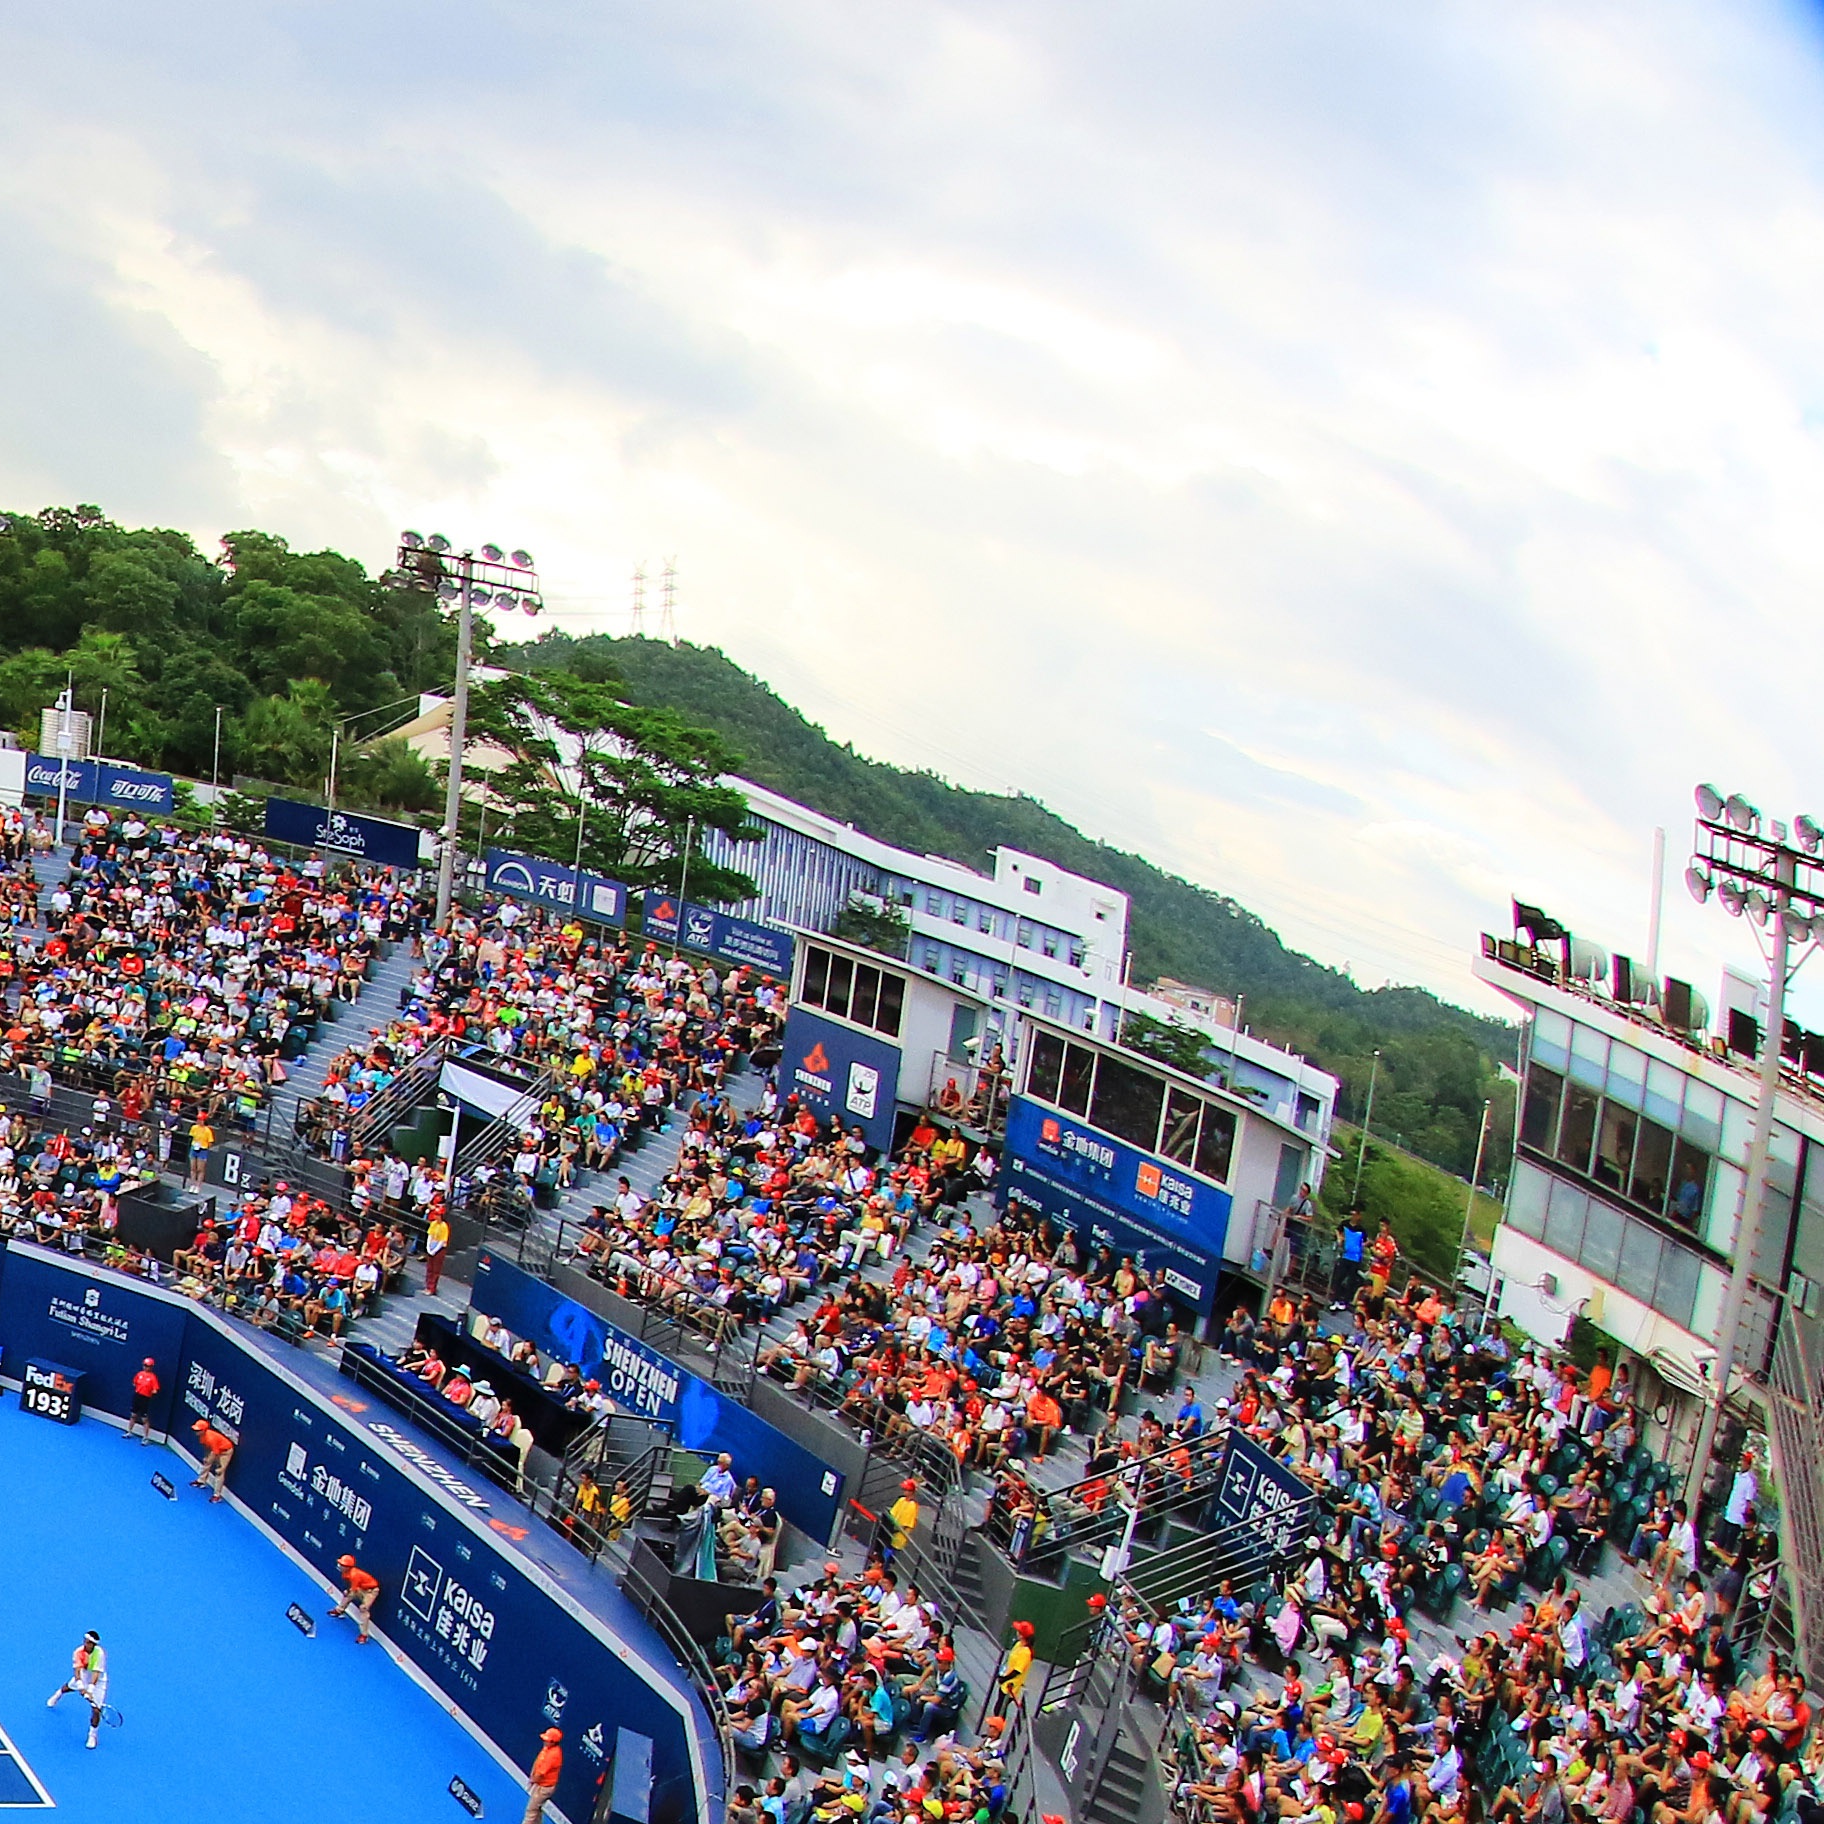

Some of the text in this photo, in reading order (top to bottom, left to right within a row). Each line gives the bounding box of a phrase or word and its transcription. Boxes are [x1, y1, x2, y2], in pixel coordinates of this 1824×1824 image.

[538, 875, 575, 904] 天虹
[26, 1365, 75, 1393] FedEx
[602, 1337, 679, 1404] SHENZHEN
[610, 1368, 661, 1417] OPEN
[311, 1465, 373, 1533] 金地集团
[367, 1422, 490, 1513] SHENZHEN
[434, 1607, 486, 1672] 佳兆业
